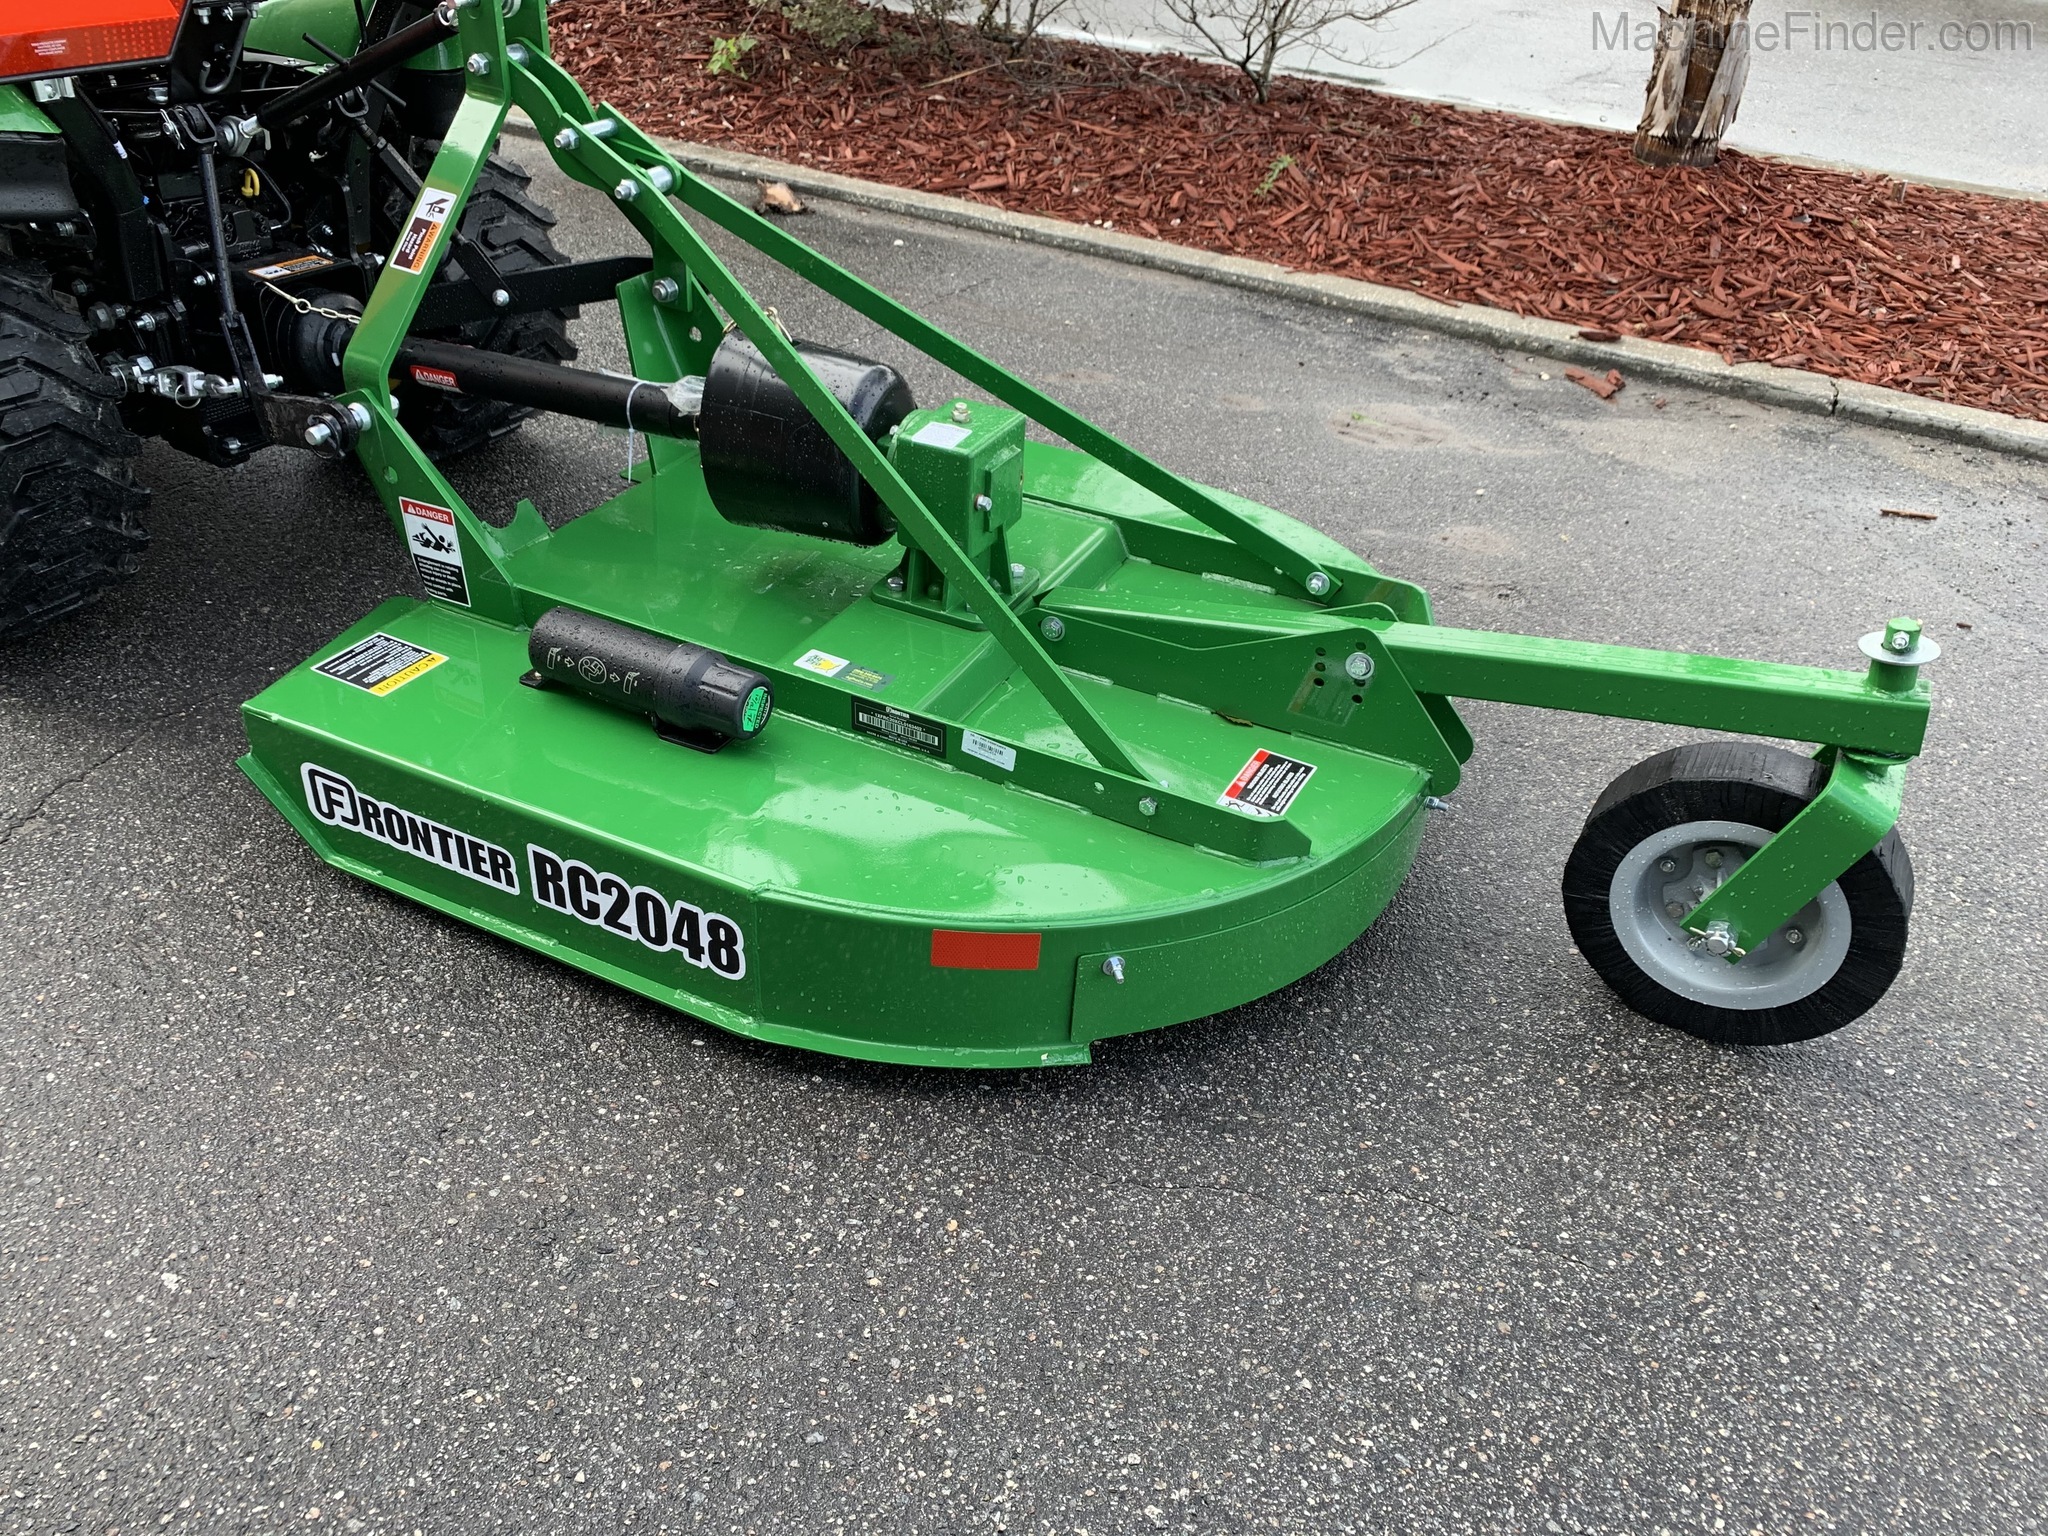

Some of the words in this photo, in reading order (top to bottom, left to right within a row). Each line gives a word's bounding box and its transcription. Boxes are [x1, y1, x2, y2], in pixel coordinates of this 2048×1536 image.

[413, 230, 435, 269] WARNING
[423, 371, 456, 387] DANGER
[415, 506, 449, 522] DANGER
[378, 662, 429, 692] CAUTION
[755, 692, 768, 729] INSPECTED
[1240, 760, 1261, 781] DANGER
[307, 767, 517, 892] FRONTIER
[531, 848, 741, 977] RC2048
